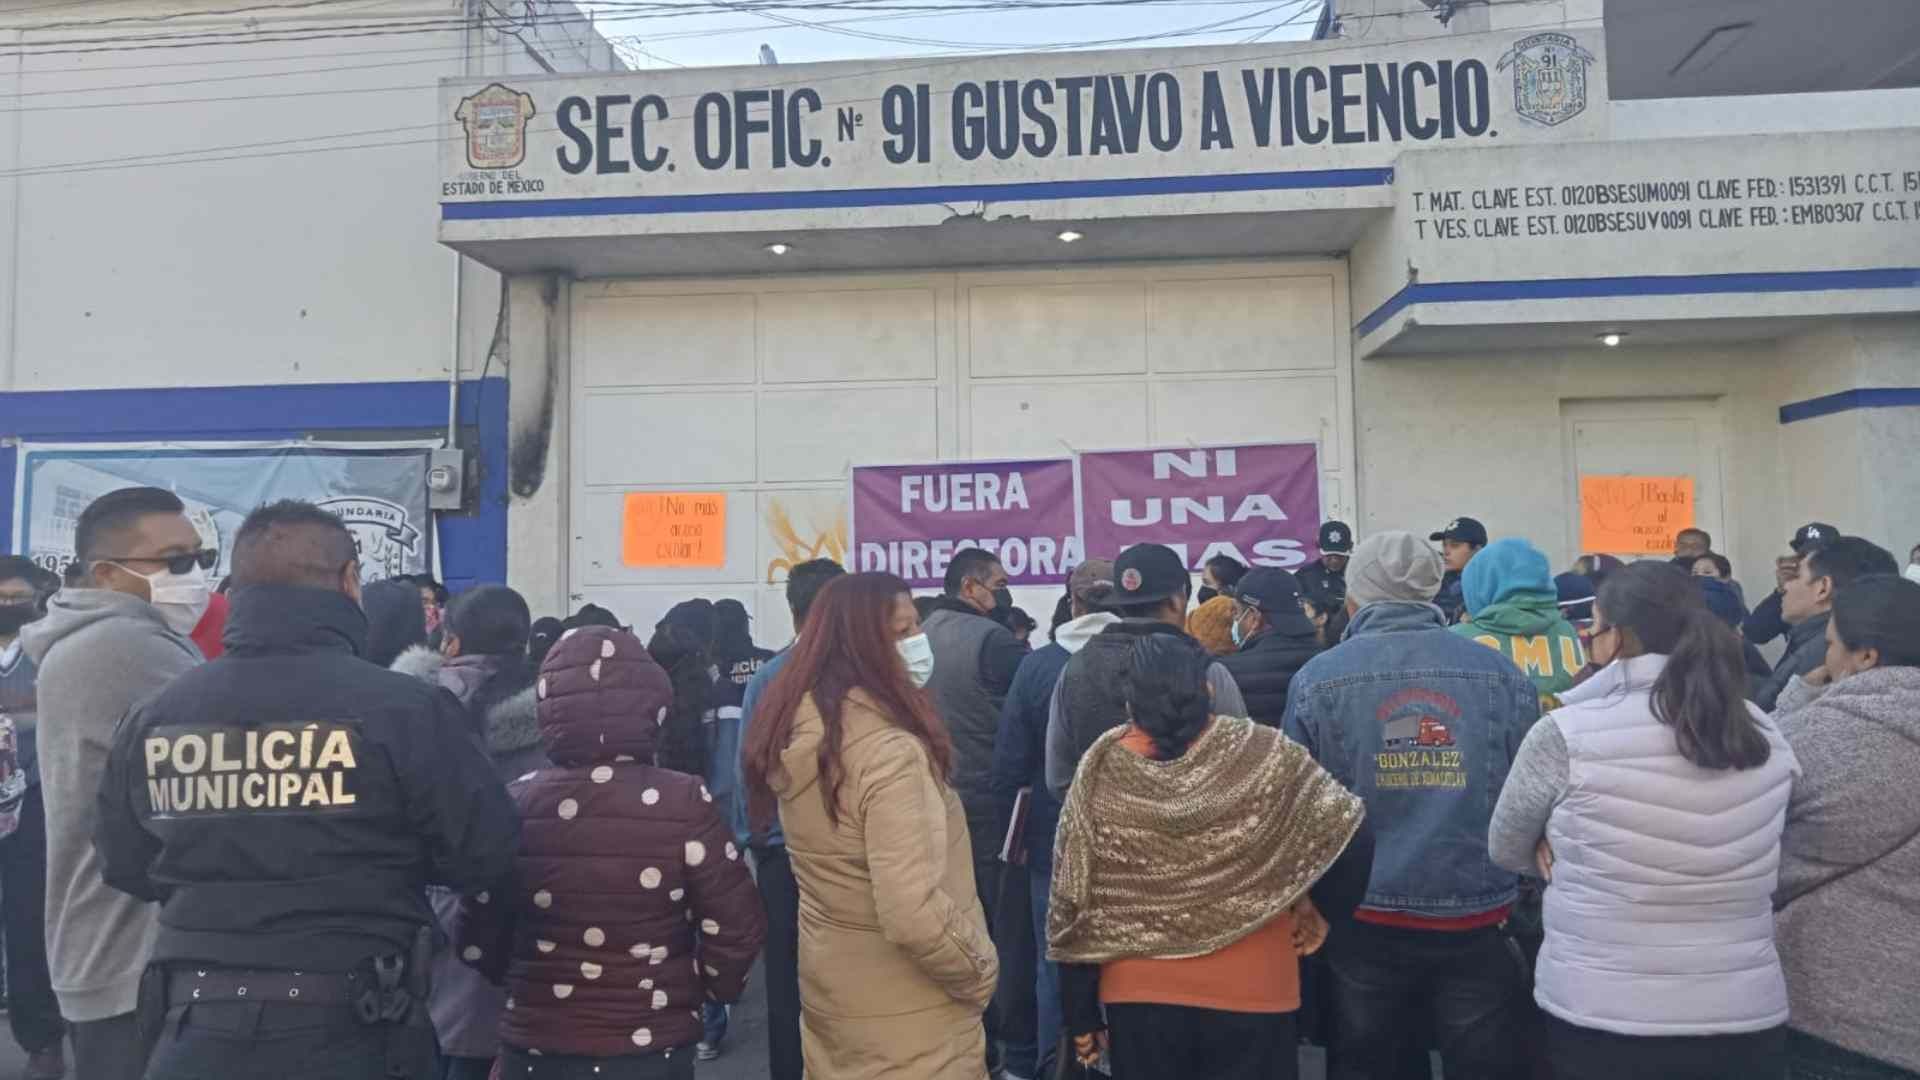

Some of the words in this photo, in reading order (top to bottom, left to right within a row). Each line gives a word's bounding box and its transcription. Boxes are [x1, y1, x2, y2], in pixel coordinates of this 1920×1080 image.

[1541, 54, 1557, 67] 91
[556, 94, 676, 176] SEC.
[694, 88, 831, 170] OFIC.
[882, 83, 930, 164] 91
[952, 72, 1182, 161] GUSTAVO
[1200, 71, 1234, 150] A
[1241, 59, 1498, 147] VICENCIO.
[442, 181, 485, 196] ESTADO
[489, 180, 503, 194] DE
[1430, 191, 1465, 213] MAT.
[1472, 187, 1519, 210] CLAVE
[1525, 186, 1557, 207] EST.
[1697, 179, 1742, 200] CLAVE
[1789, 173, 1846, 196] 1531391
[1903, 170, 1920, 192] 15
[1434, 218, 1470, 239] VES.
[1474, 216, 1520, 238] CLAVE
[1527, 215, 1559, 236] EST.
[1699, 207, 1744, 230] CLAVE
[1153, 449, 1237, 480] NI
[901, 472, 1030, 513] FUERA
[1110, 494, 1289, 526] UNA
[1808, 526, 1820, 539] LA
[861, 536, 1085, 580] DIREORA
[145, 724, 357, 776] POLICÍA
[148, 771, 356, 812] MUNICIPAL
